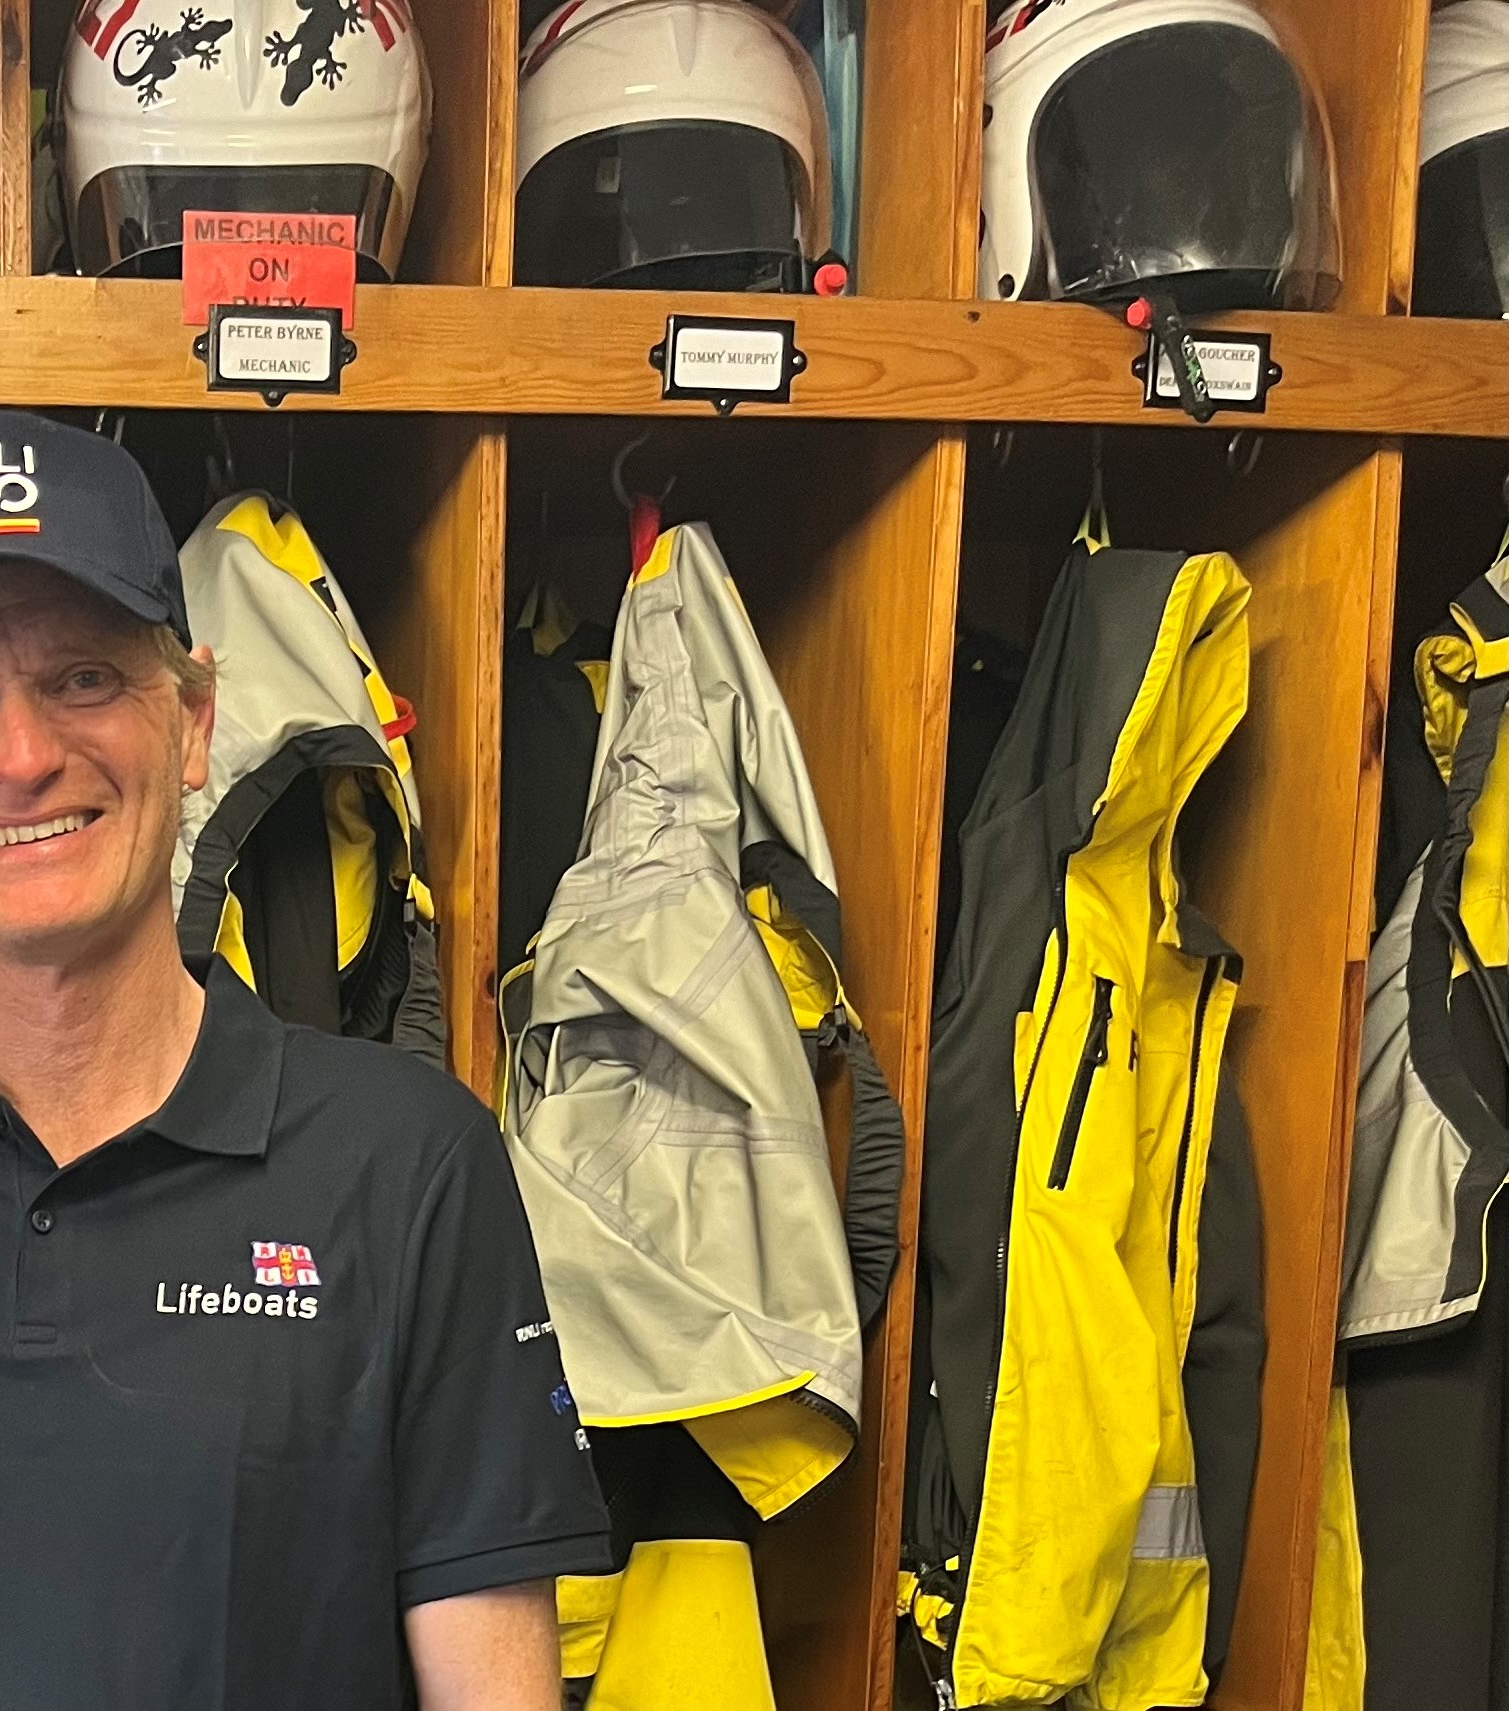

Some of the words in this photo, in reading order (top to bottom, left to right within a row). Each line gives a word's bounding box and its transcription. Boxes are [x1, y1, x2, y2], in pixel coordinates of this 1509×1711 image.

[194, 218, 345, 246] MECHANIC
[249, 257, 289, 283] ON
[227, 324, 273, 340] PETER
[277, 324, 323, 341] BYRNE
[681, 350, 726, 364] TOMMY
[727, 351, 779, 366] MURPHY
[1198, 347, 1256, 363] GOUCHER
[239, 359, 312, 374] MECHANIC
[1205, 380, 1252, 391] OXSWAIN
[156, 1281, 318, 1320] Lifeboats
